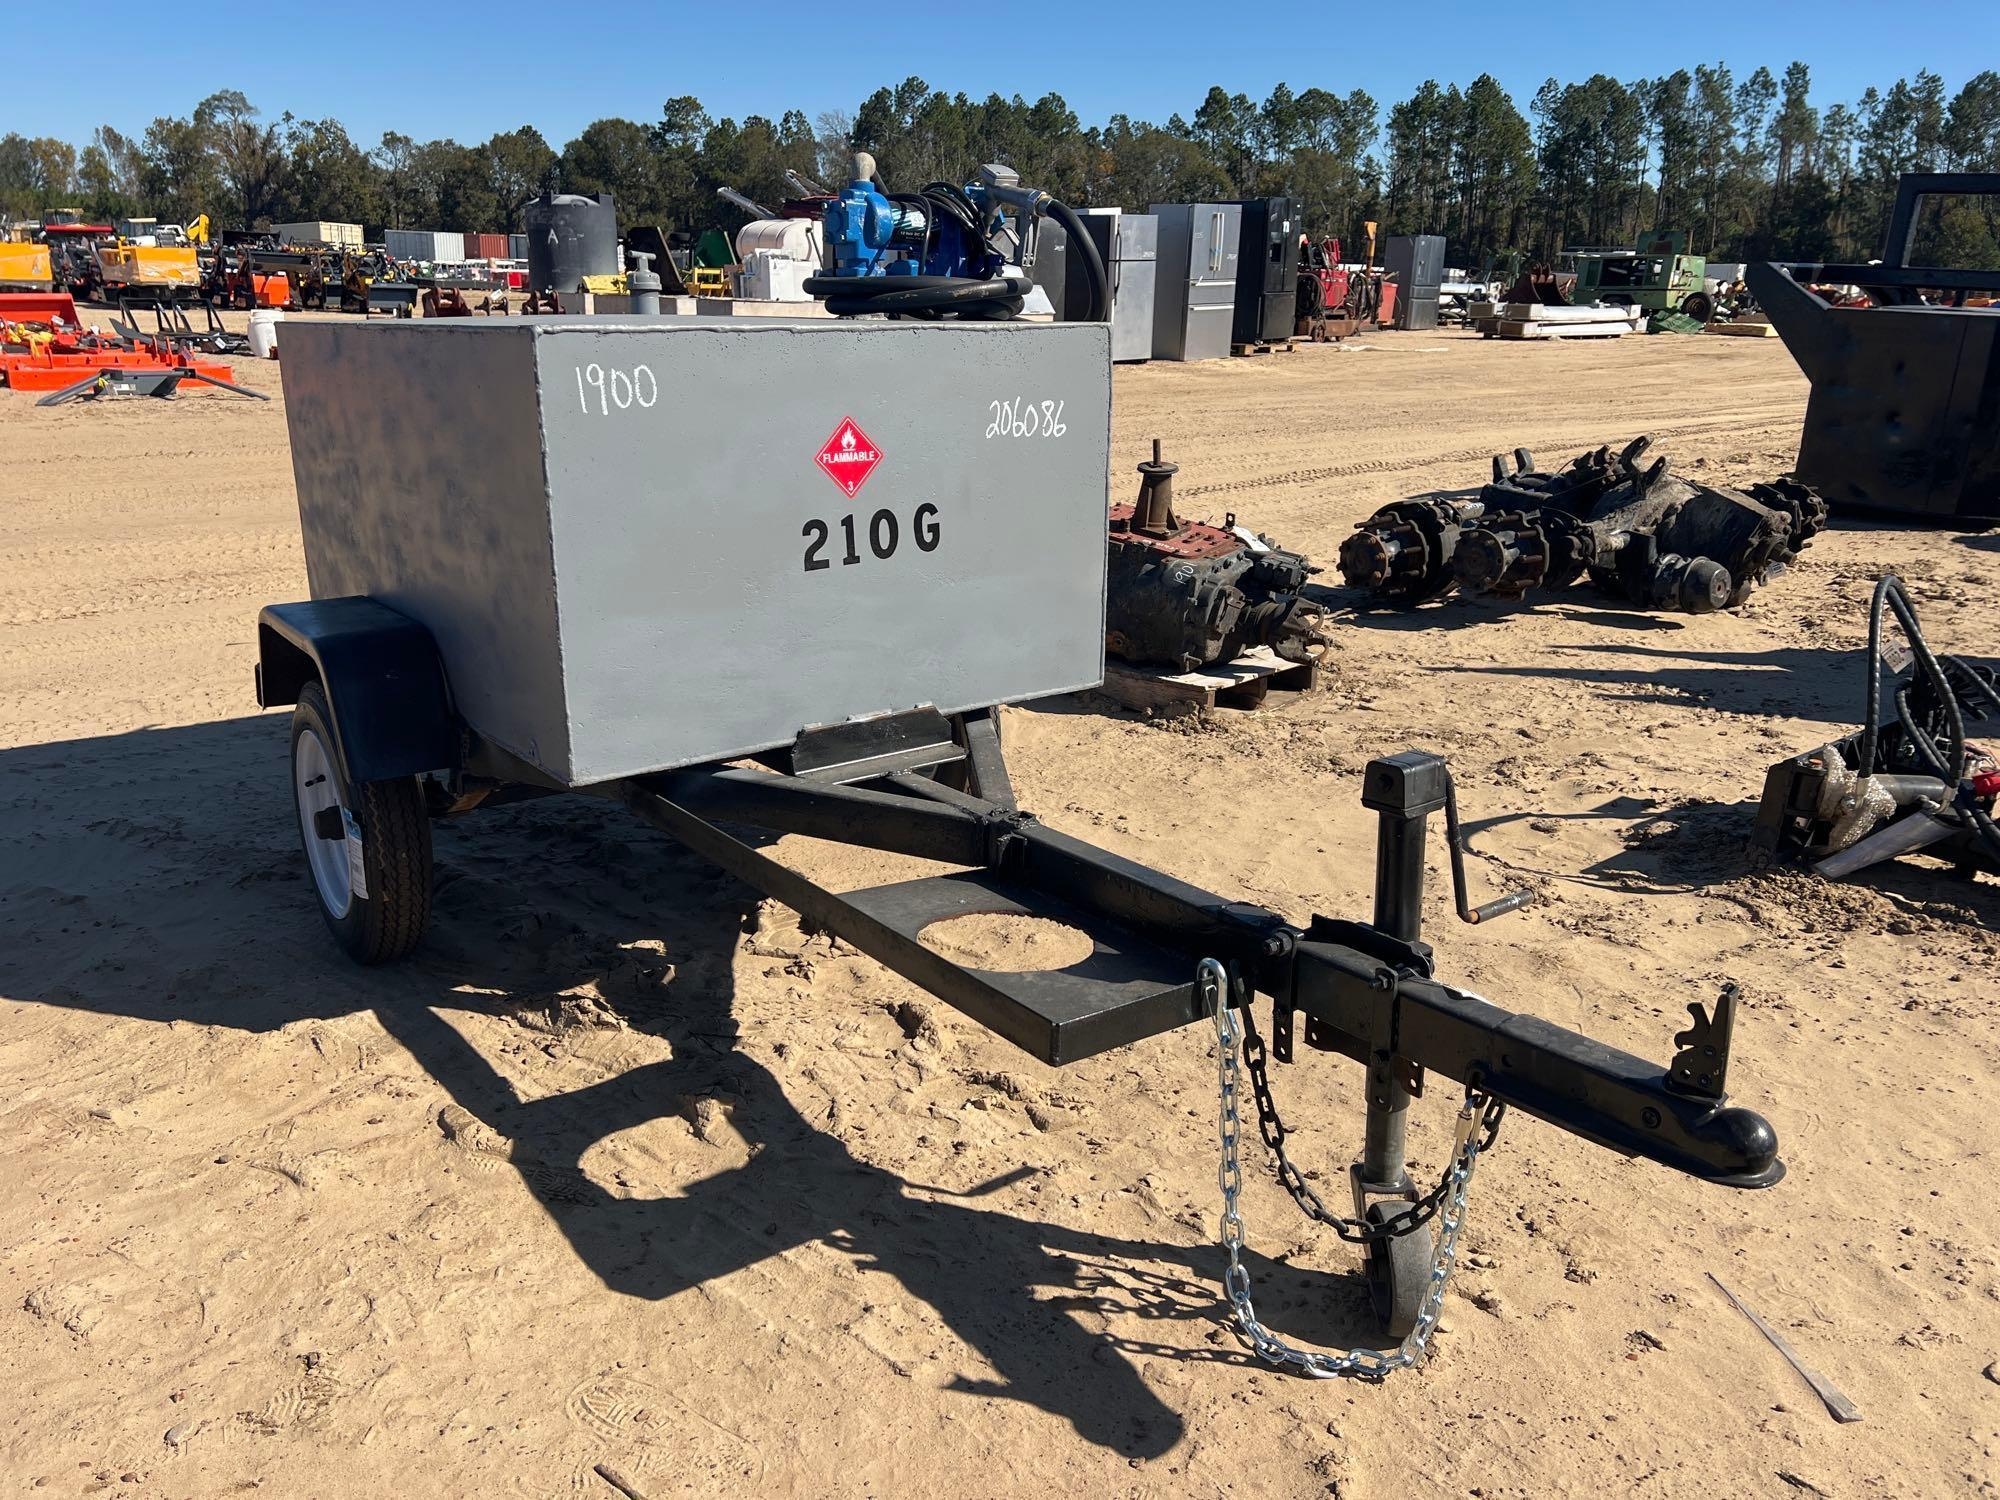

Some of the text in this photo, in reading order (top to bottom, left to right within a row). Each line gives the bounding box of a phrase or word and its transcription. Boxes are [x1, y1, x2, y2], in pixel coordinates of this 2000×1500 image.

[575, 363, 658, 416] 1900
[985, 395, 1067, 439] 206086
[822, 450, 875, 464] FLAMMABLE
[847, 480, 855, 492] 3
[802, 502, 941, 572] 210 G
[1173, 561, 1198, 585] 1901
